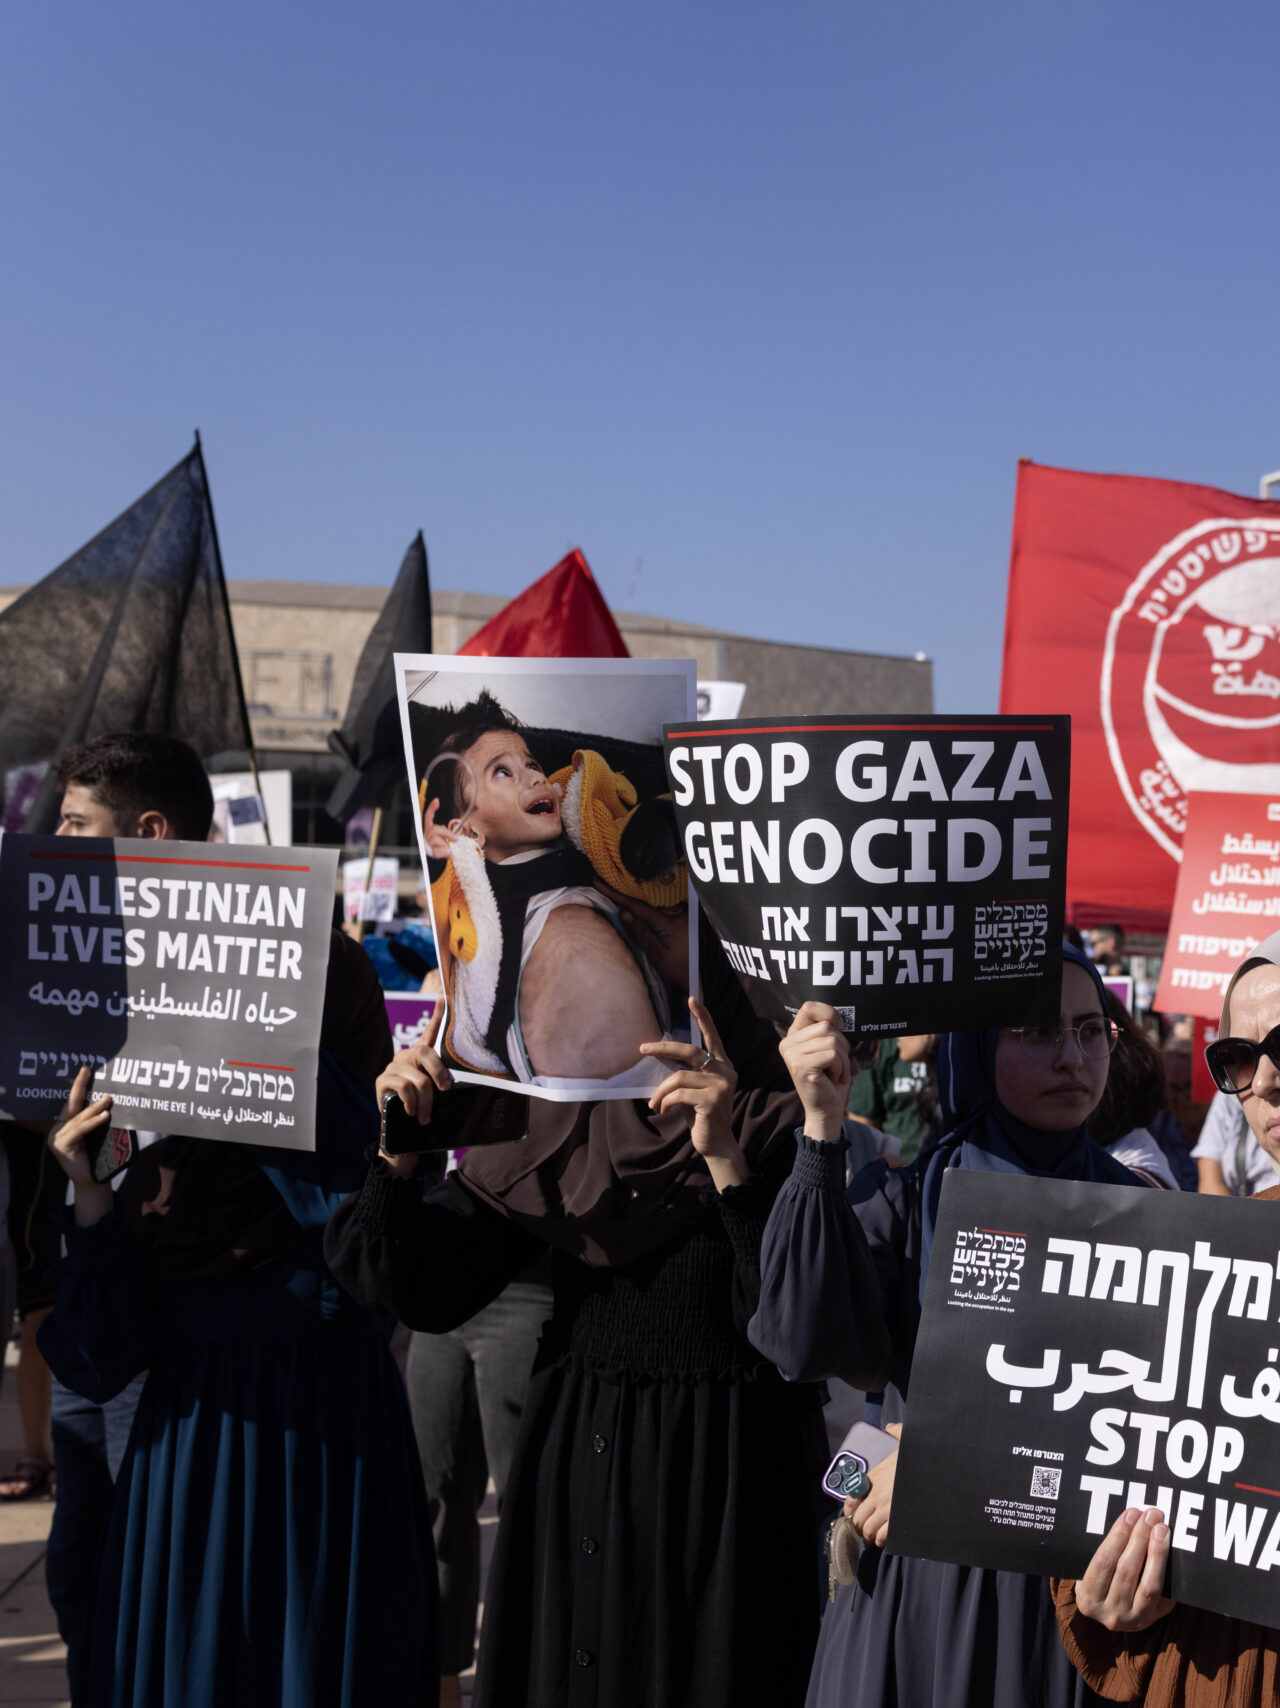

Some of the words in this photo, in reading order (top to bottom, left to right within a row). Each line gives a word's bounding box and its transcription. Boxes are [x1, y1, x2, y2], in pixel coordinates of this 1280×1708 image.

[669, 742, 810, 806] STOP
[835, 740, 1053, 802] GAZA
[684, 817, 1052, 884] GENOCIDE
[1221, 833, 1280, 862] يسقط
[27, 872, 306, 929] PALESTINIAN
[974, 900, 1048, 921] מסתכלים
[761, 906, 811, 941] את
[826, 904, 955, 942] עיצרו
[974, 919, 1048, 939] לכיבוש
[27, 923, 146, 967] LIVES
[156, 930, 303, 980] MATTER
[720, 938, 772, 981] בעזה
[974, 937, 1047, 961] בעיניים
[245, 991, 297, 1032] حياه
[111, 1057, 191, 1090] לכיבוש
[195, 1058, 295, 1102] מסתכלים
[140, 1097, 151, 1109] IN
[152, 1099, 169, 1112] THE
[170, 1101, 187, 1114] EYE
[222, 1106, 234, 1125] في
[956, 1227, 1027, 1253] מסתכלים
[953, 1248, 1025, 1271] לכיבוש
[950, 1264, 1021, 1294] בעיניים
[986, 1300, 1214, 1412] الحرب
[1012, 1446, 1033, 1457] אלינו
[1033, 1449, 1064, 1461] הצטרפו
[1085, 1408, 1244, 1485] STOP
